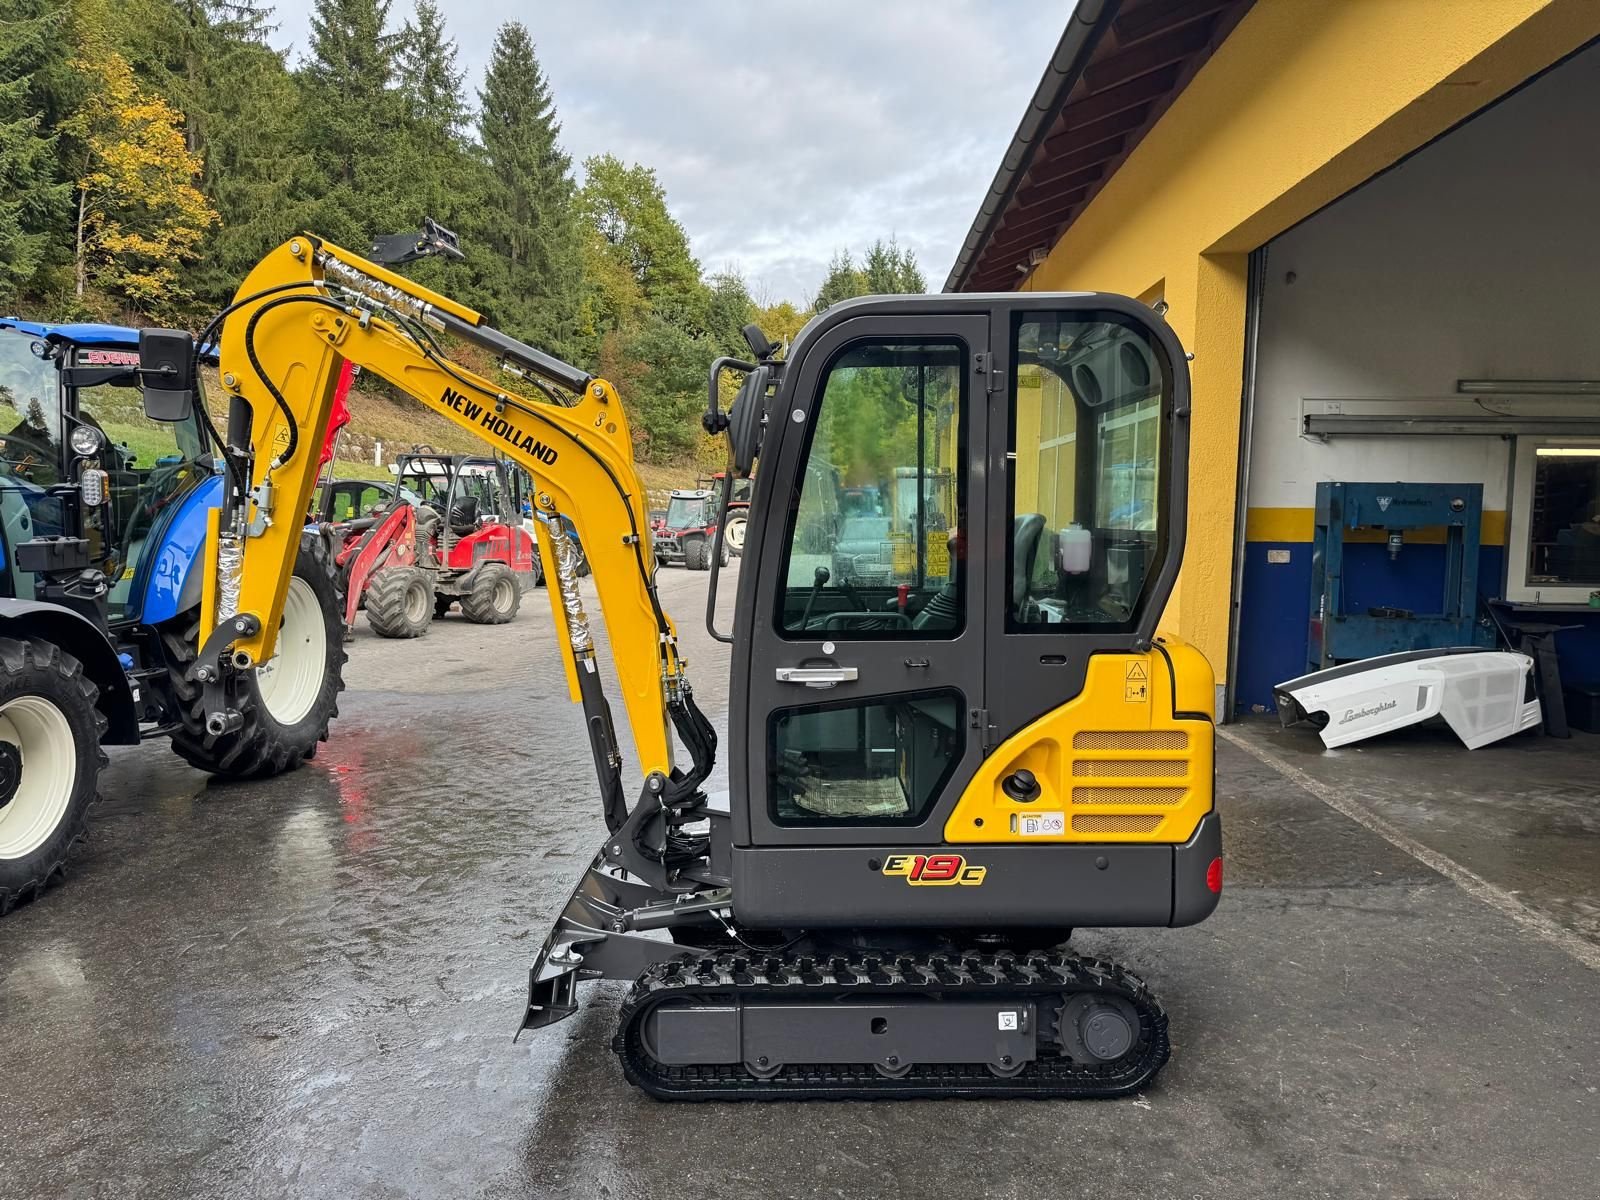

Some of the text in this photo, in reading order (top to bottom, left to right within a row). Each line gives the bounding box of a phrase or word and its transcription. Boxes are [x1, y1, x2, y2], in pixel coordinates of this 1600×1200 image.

[440, 387, 559, 466] NEW HOLLAND
[1339, 700, 1397, 725] Lamborghini
